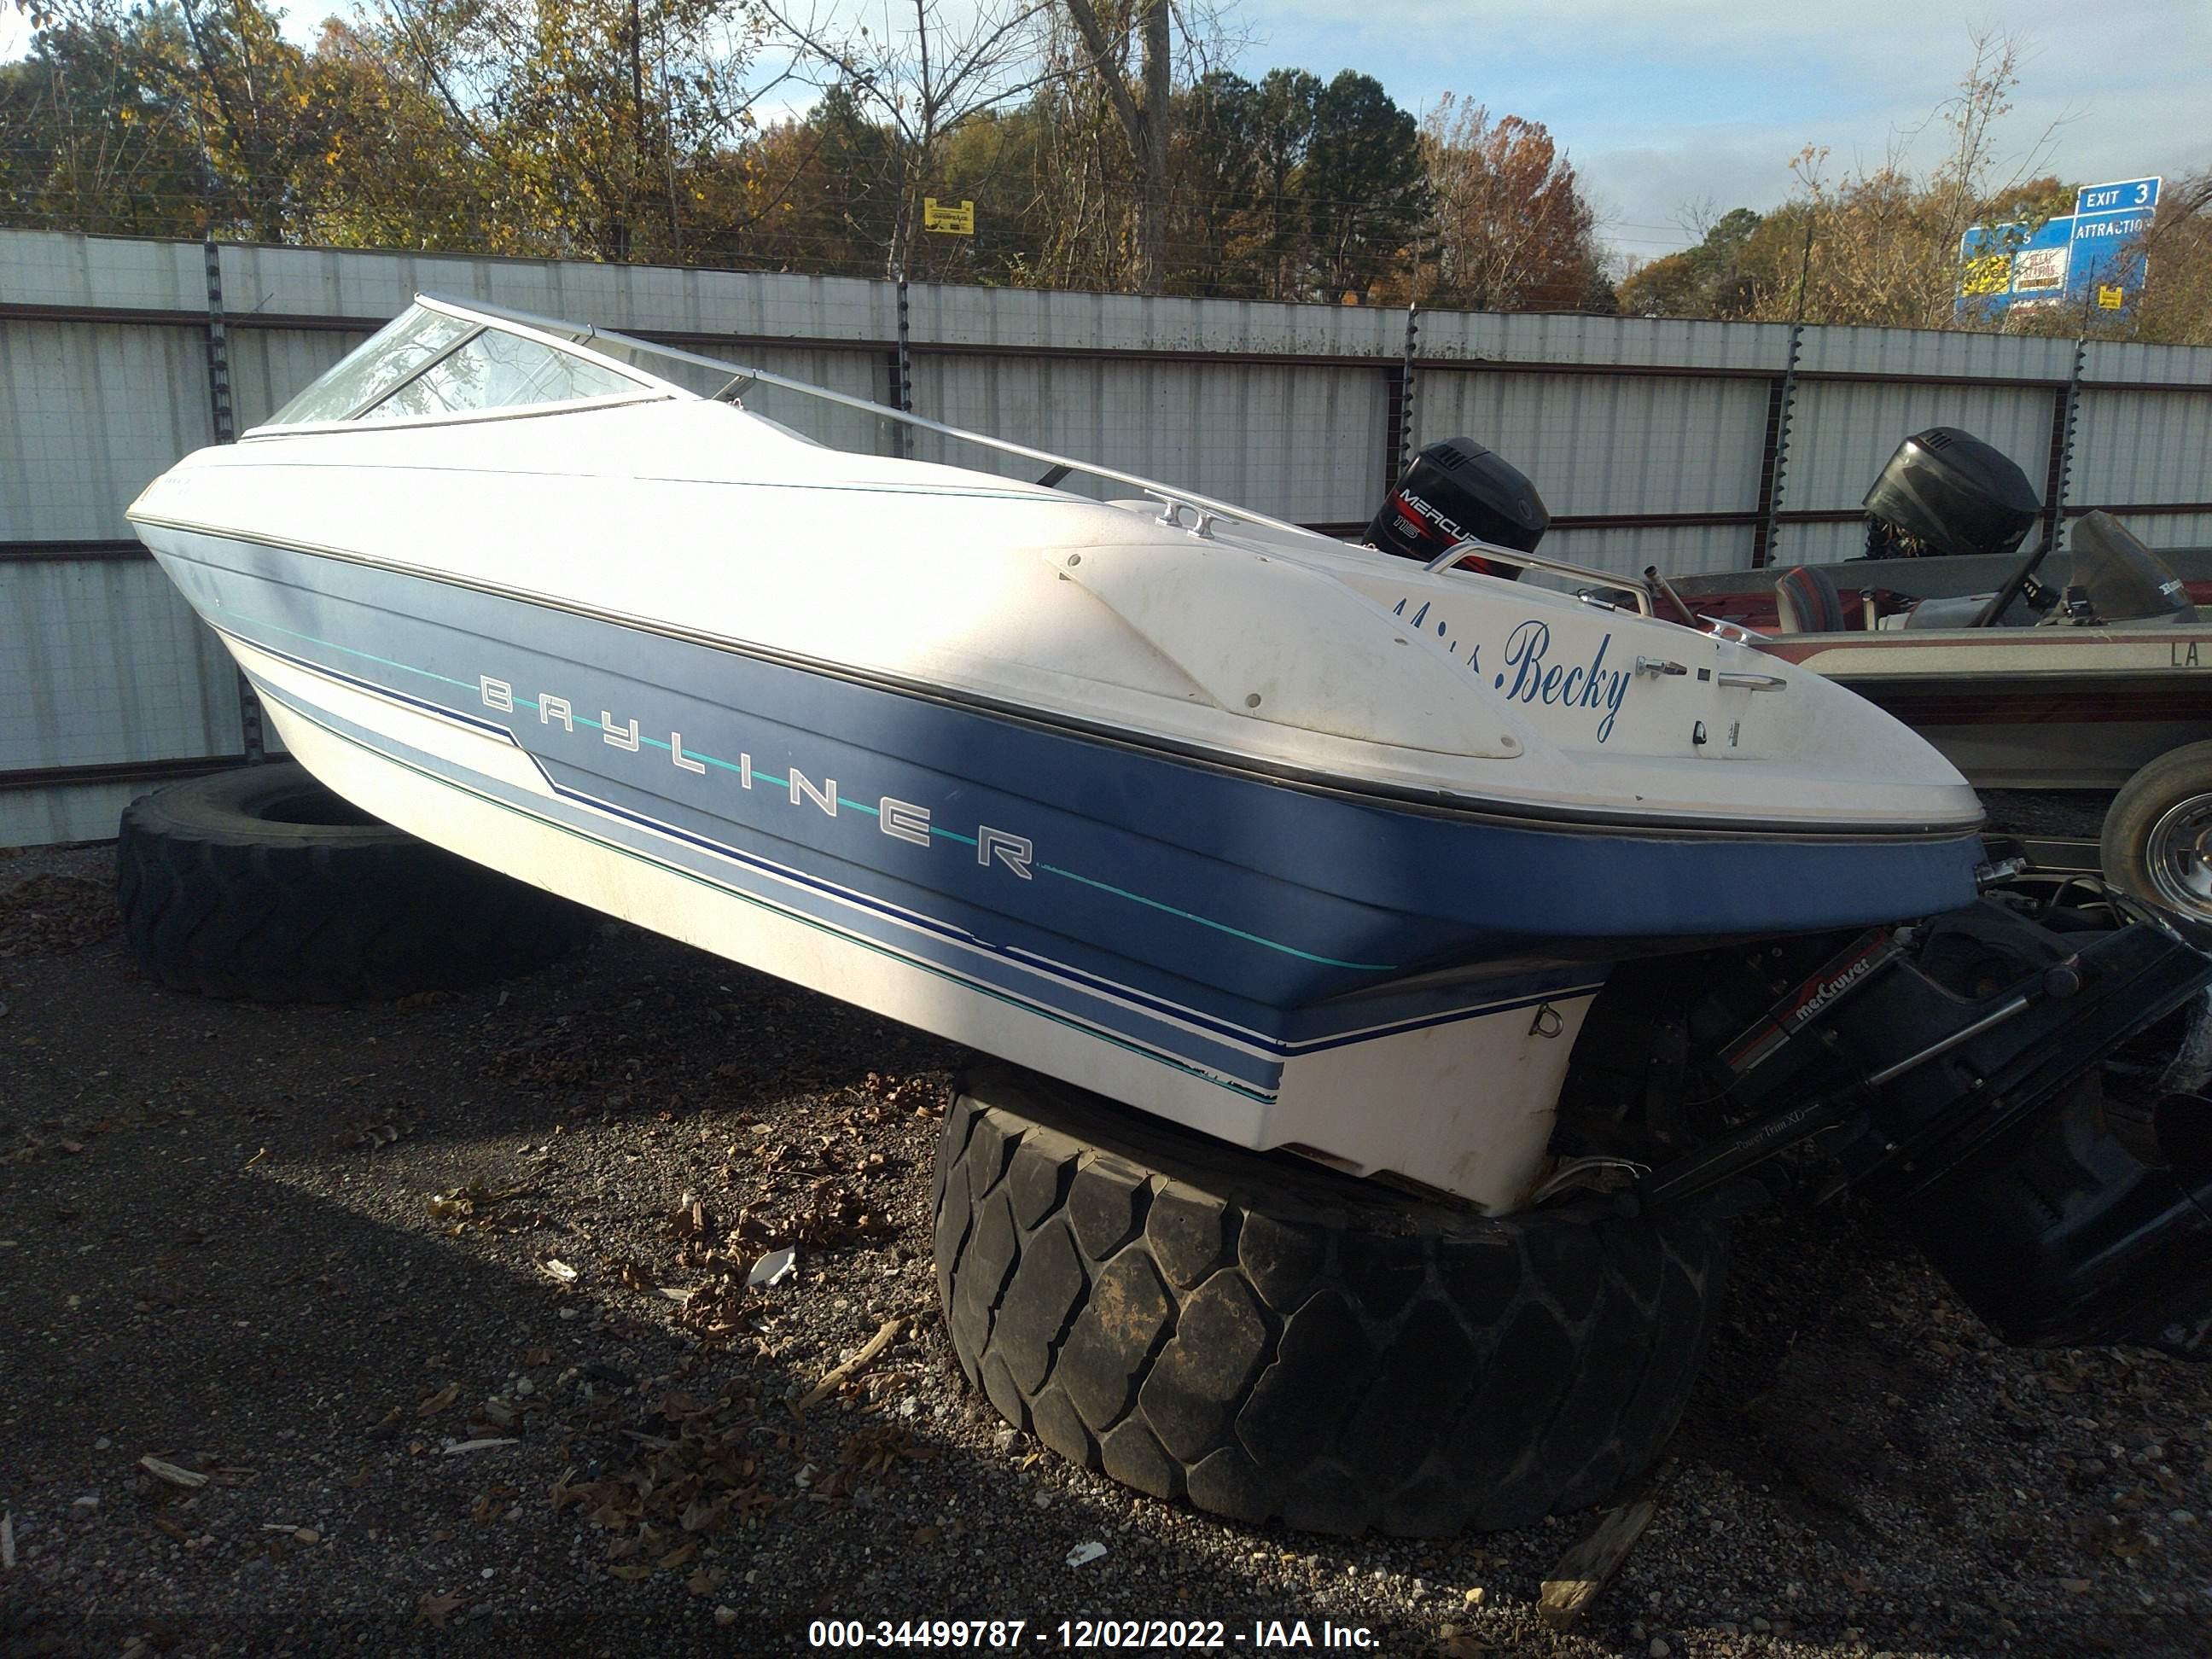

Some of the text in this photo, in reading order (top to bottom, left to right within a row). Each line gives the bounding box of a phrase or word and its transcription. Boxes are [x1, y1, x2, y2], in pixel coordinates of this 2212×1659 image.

[2087, 183, 2148, 207] EXIT 3
[1393, 515, 1420, 539] 115
[1400, 489, 1482, 543] MERCUR
[2171, 642, 2198, 667] LA
[1505, 620, 1631, 743] Becky
[480, 674, 1033, 880] BAYLINER
